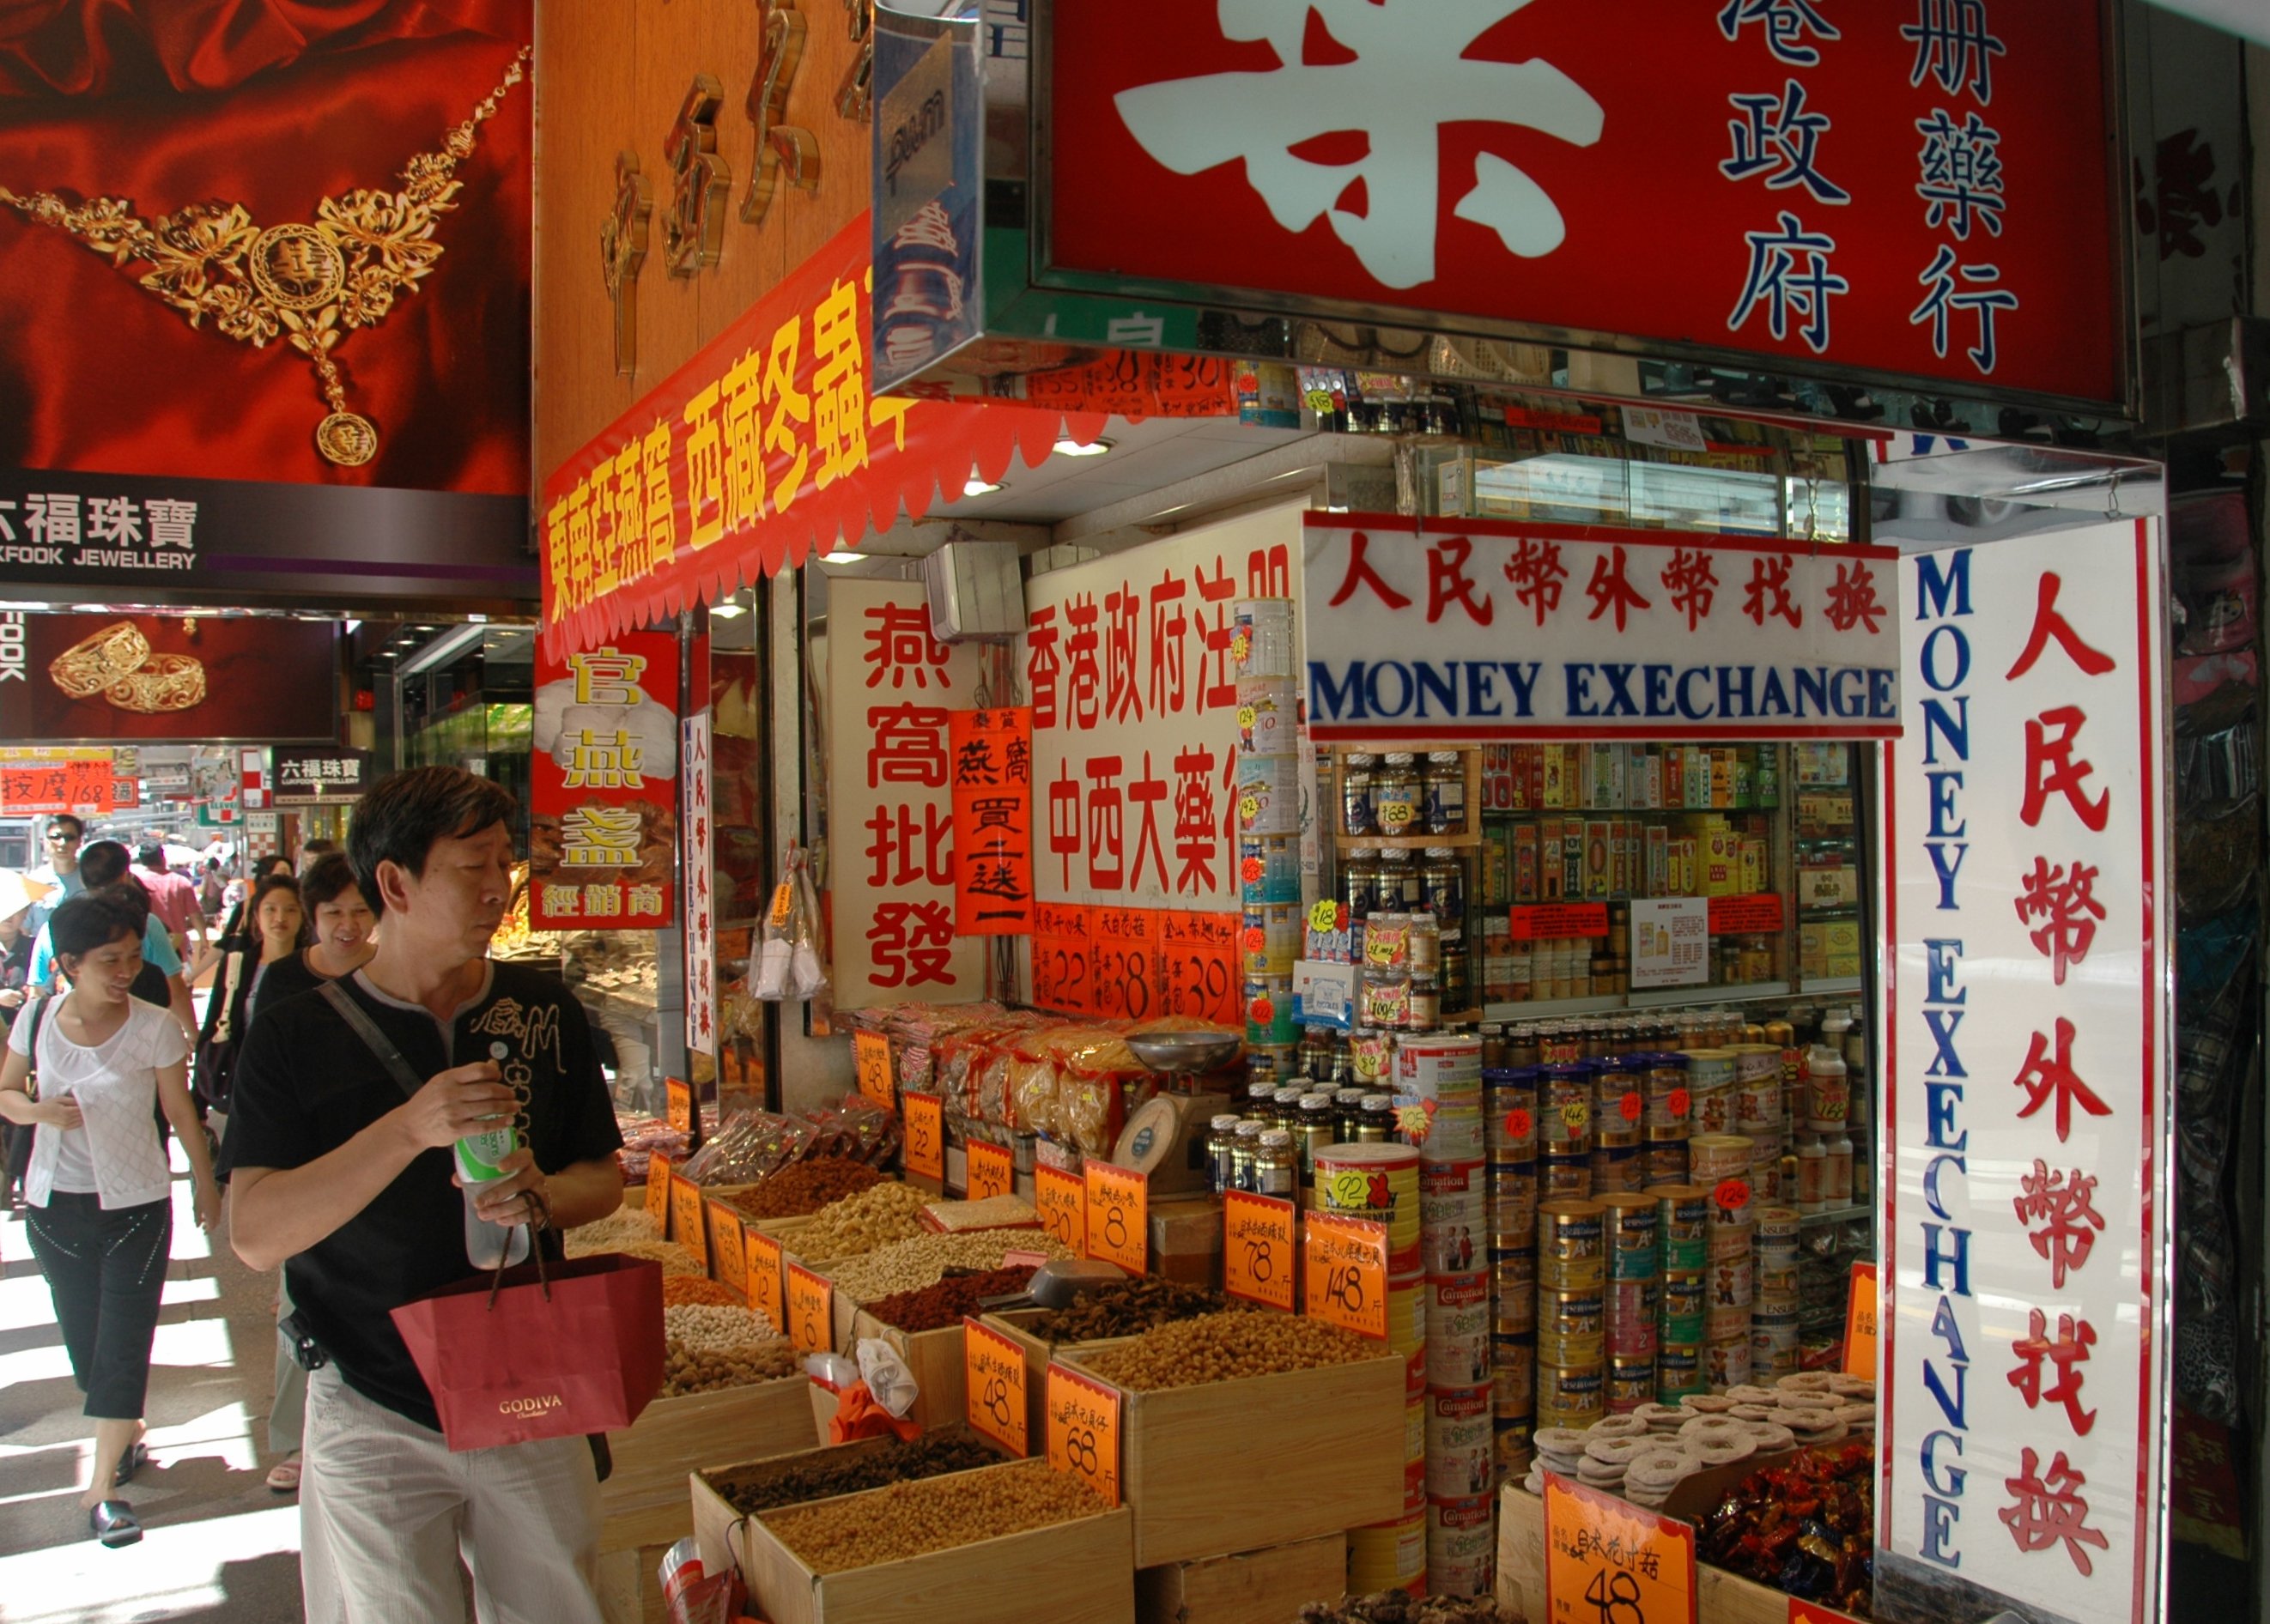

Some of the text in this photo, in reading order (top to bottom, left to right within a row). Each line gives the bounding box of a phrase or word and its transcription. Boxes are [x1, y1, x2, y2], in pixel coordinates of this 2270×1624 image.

[684, 265, 920, 551] 西藏冬蟲
[73, 548, 197, 570] JEWELLERY
[1329, 530, 1887, 634] 人民幣外幣找換
[1308, 660, 1897, 724] MONEY EXECHANGE
[281, 759, 361, 779] 六福珠寶
[562, 647, 646, 866] 官燕盞
[956, 736, 1029, 786] 燕窩
[864, 601, 957, 988] 燕窩批發
[967, 797, 1029, 922] 買二送一
[542, 884, 663, 918] 經銷商
[1053, 949, 1086, 1009] 22
[1914, 548, 1975, 1570] MONEY EXECHANGE
[1997, 571, 2117, 1579] 人民幣外幣找換
[1338, 1176, 1364, 1203] 92
[1105, 1206, 1126, 1249] 8
[1244, 1240, 1273, 1283] 78
[1325, 1266, 1363, 1312] 148
[1637, 1332, 1648, 1348] 2
[499, 1394, 562, 1414] GODIVA
[983, 1377, 1011, 1427] 48
[1067, 1426, 1097, 1476] 68
